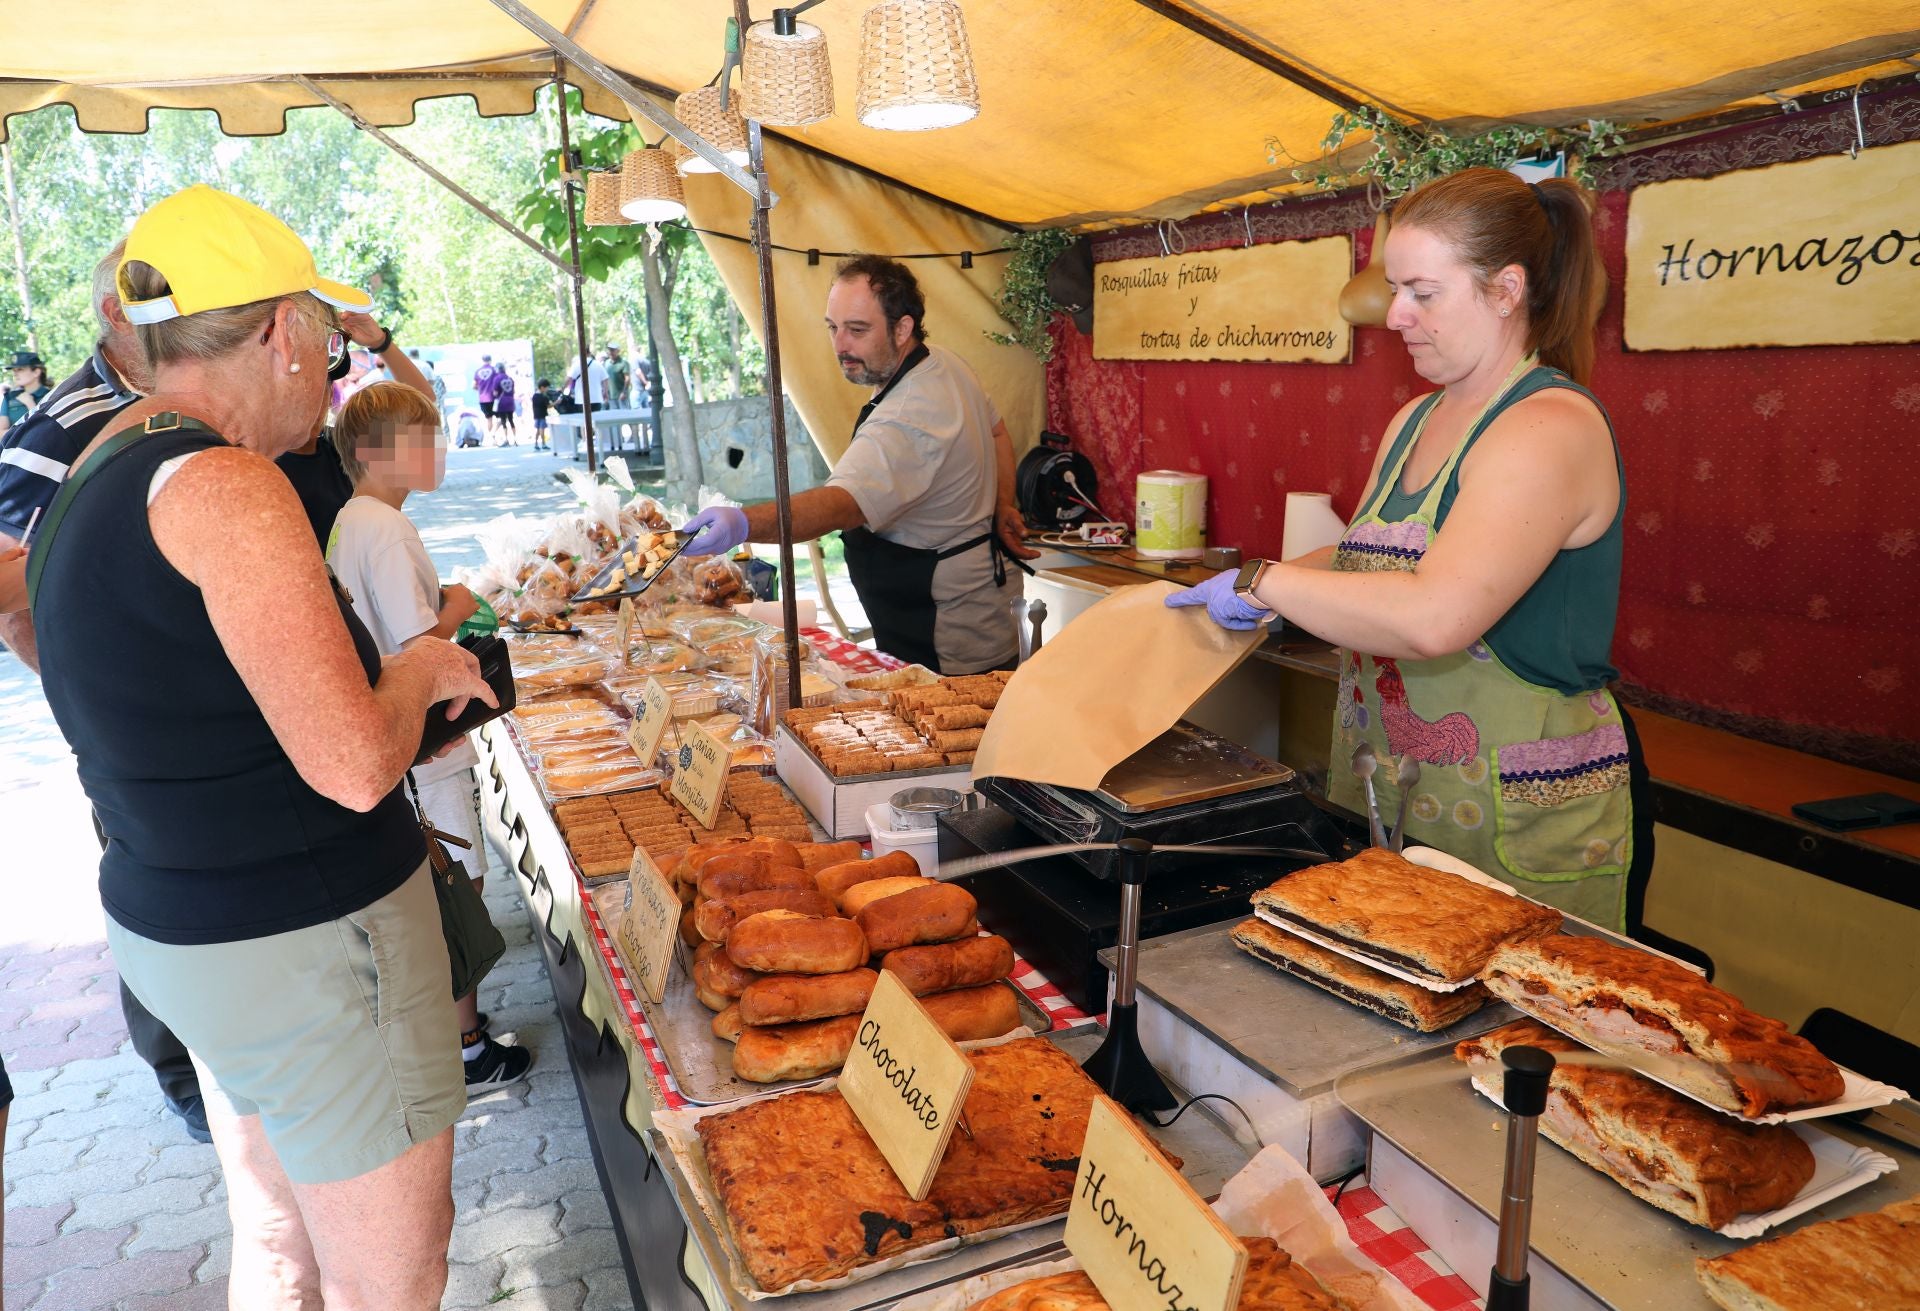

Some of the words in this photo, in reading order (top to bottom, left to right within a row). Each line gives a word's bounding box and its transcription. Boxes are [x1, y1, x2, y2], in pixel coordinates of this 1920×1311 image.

[1101, 267, 1169, 296] Rosquillas
[1177, 263, 1221, 289] fritas
[1187, 296, 1198, 316] y
[1140, 329, 1180, 349] tortas
[1189, 327, 1211, 347] de
[1217, 324, 1337, 349] chicharrones
[859, 1020, 940, 1130] Chocolate
[1082, 1160, 1199, 1311] Hornaz
